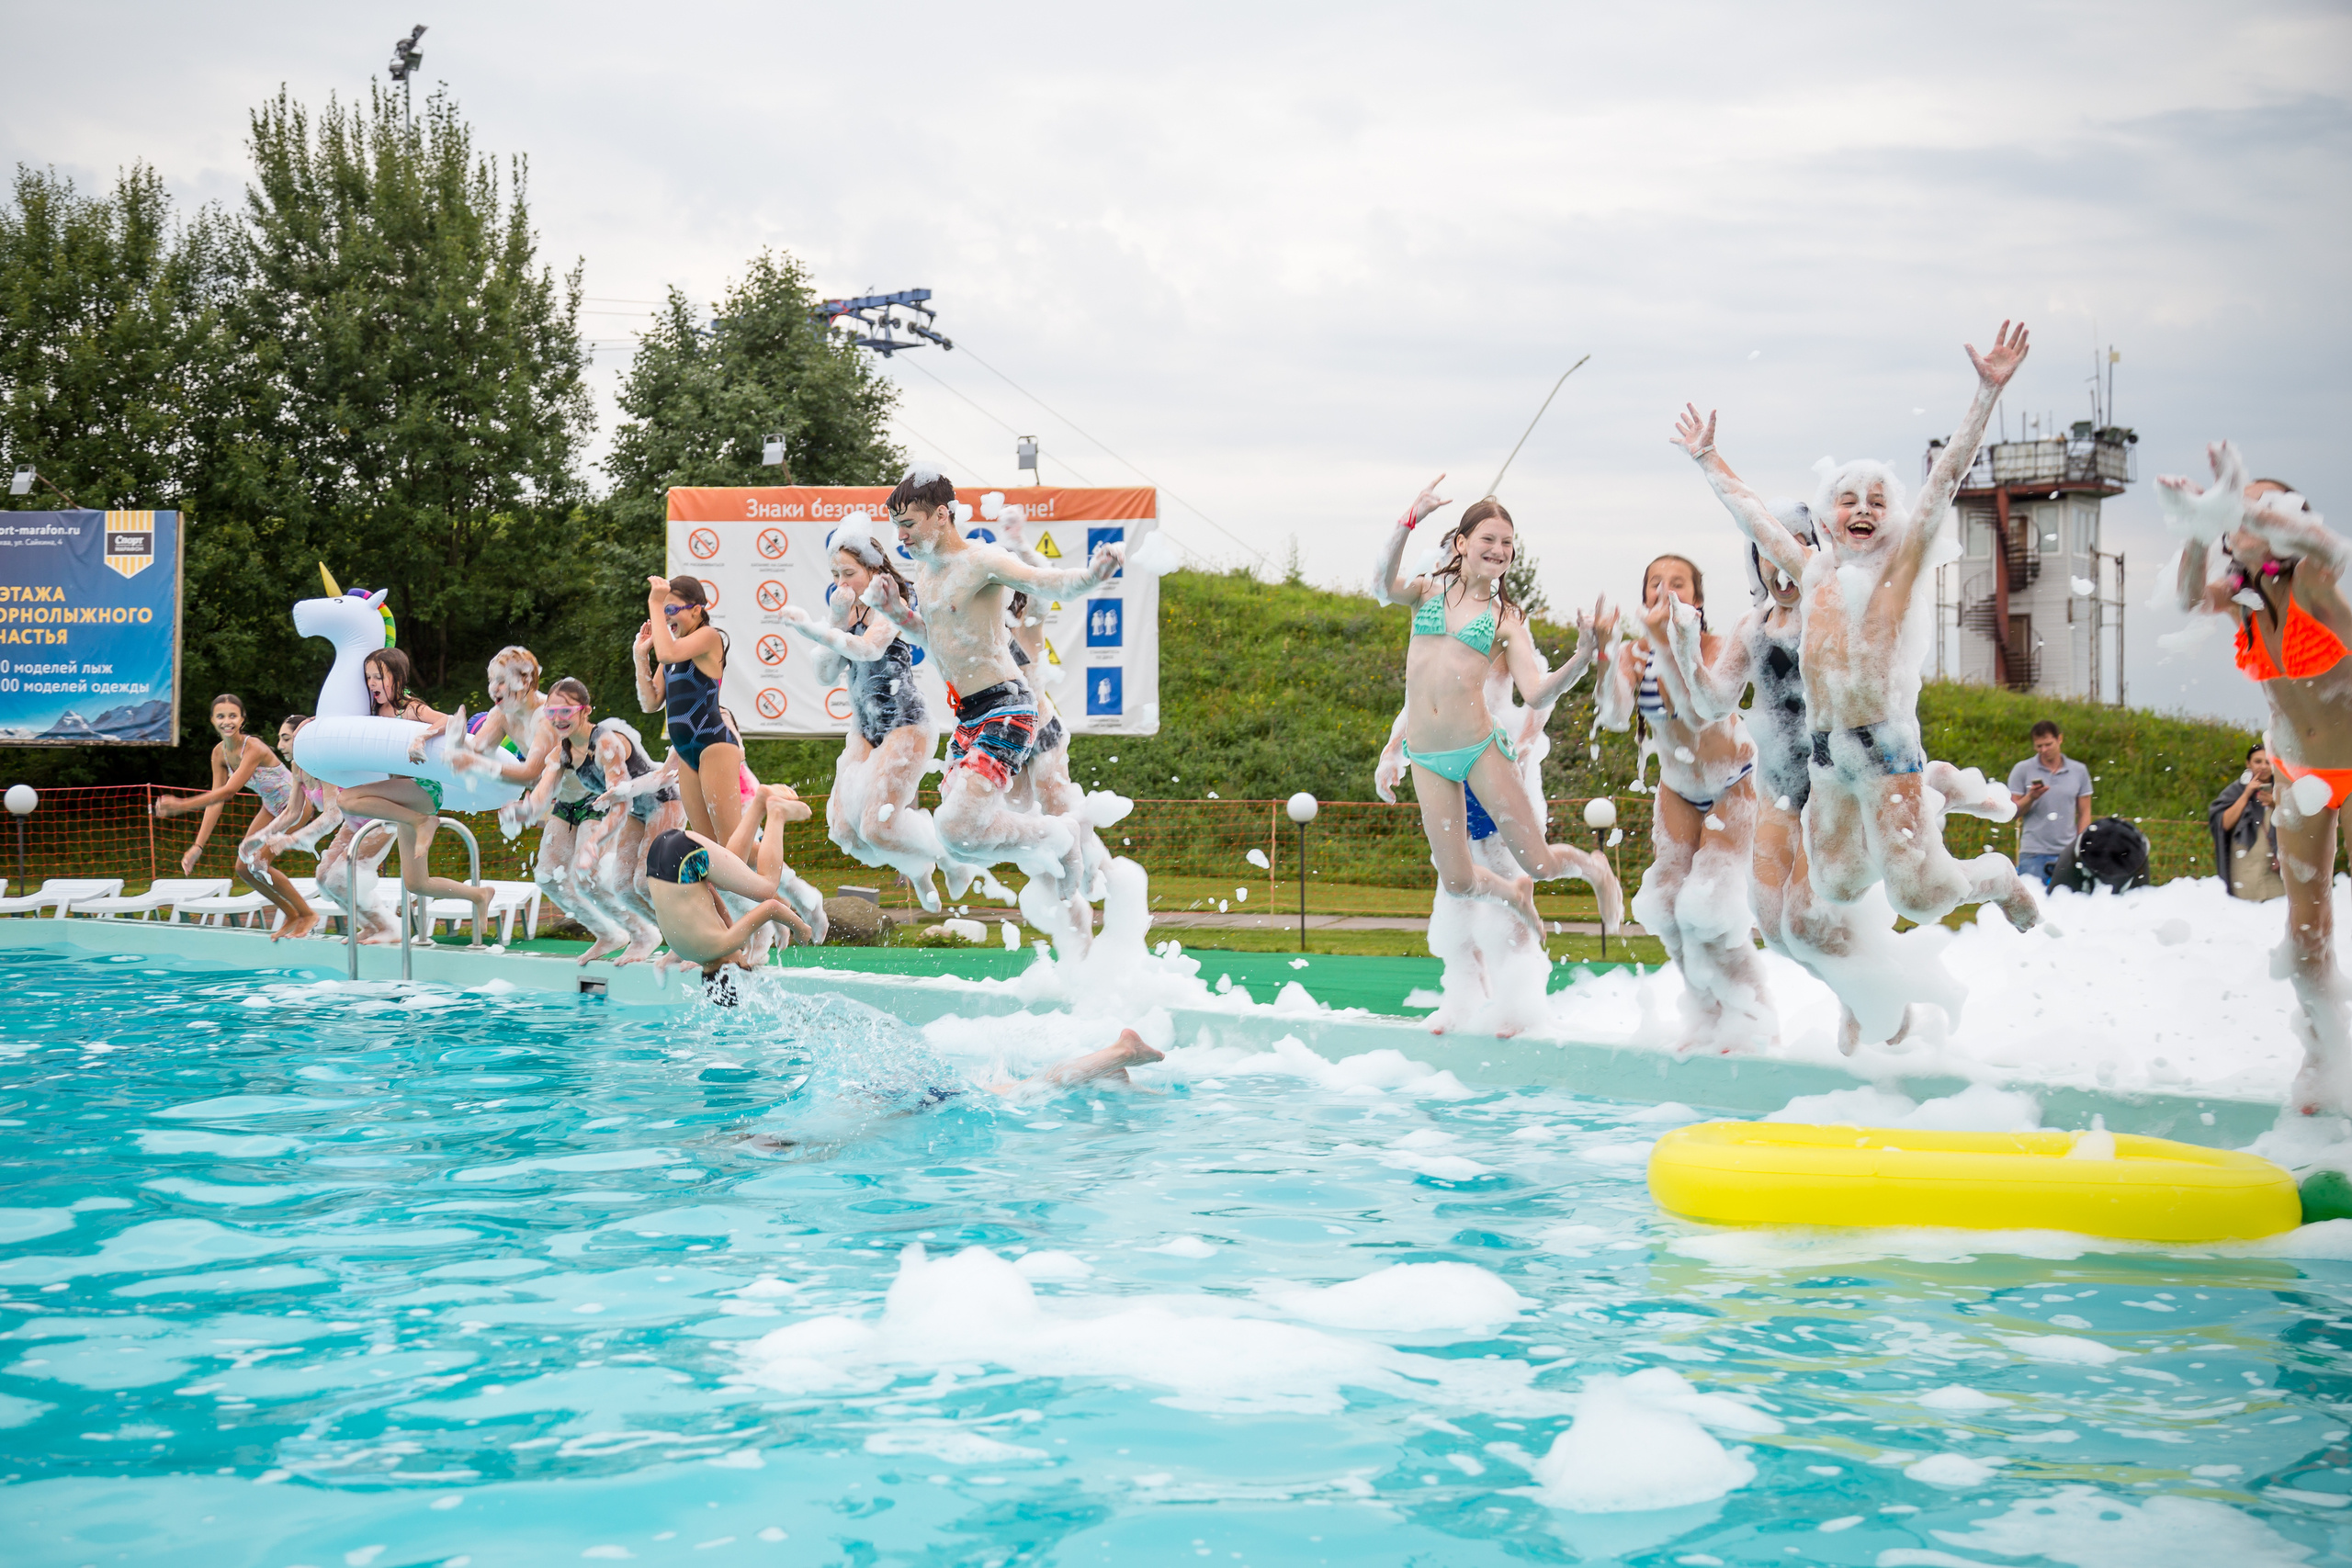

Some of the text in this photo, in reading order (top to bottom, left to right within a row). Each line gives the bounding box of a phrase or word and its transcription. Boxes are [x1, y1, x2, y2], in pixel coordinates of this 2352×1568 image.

[745, 498, 888, 518] Знаки безопас
[114, 535, 144, 546] Спорт
[0, 586, 66, 603] ЭТАЖА
[14, 660, 77, 675] моделей
[81, 664, 114, 674] лыж
[24, 680, 87, 694] моделей
[91, 682, 150, 694] одежды
